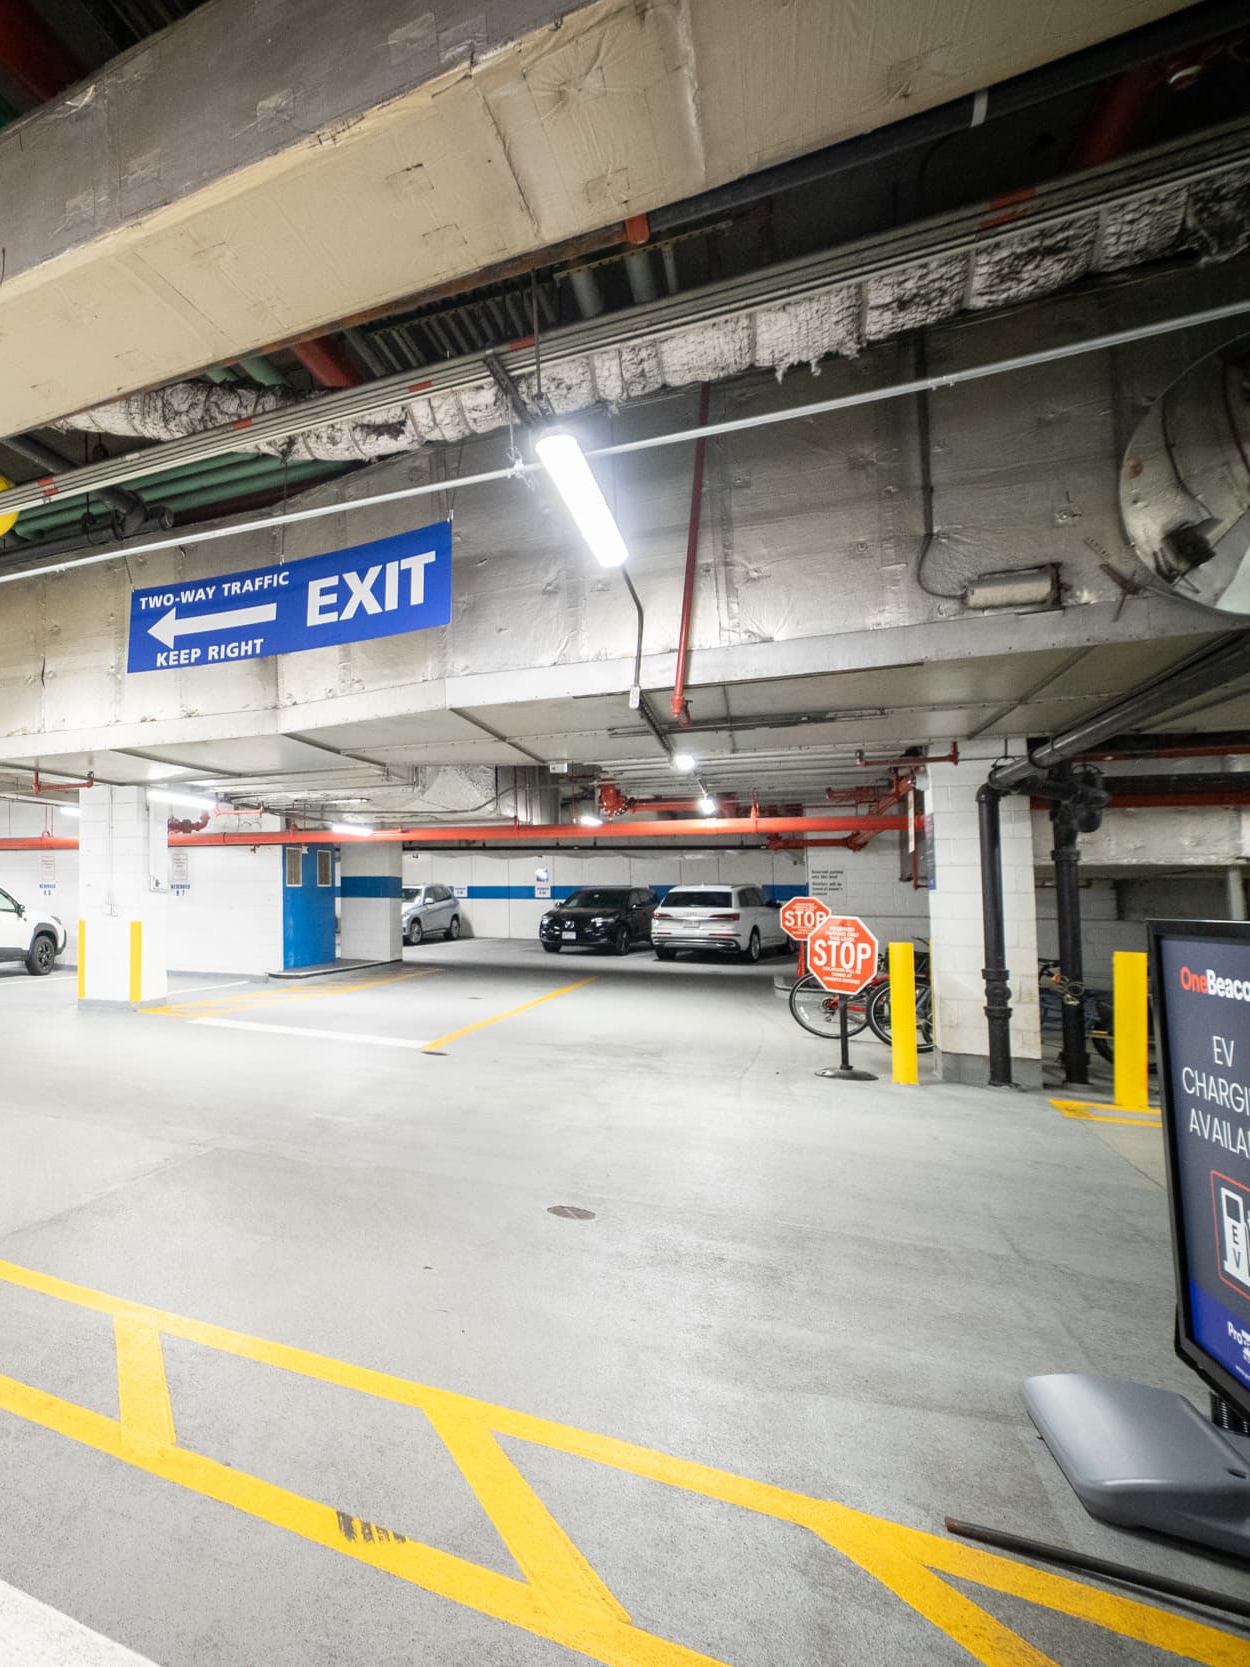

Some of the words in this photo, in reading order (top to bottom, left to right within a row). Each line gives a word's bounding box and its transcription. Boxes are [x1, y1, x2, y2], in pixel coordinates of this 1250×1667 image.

[139, 585, 216, 610] TWO-WAY
[222, 571, 290, 597] TRAFFIC
[306, 550, 436, 627] EXIT
[156, 648, 201, 667] KEEP
[207, 638, 264, 661] RIGHT
[784, 910, 826, 928] STOP
[813, 939, 871, 971] STOP
[1180, 966, 1250, 1002] OneBeaco
[1213, 1035, 1234, 1067] EV
[1182, 1067, 1250, 1116] CHARGI
[1190, 1108, 1250, 1158] AVAILA
